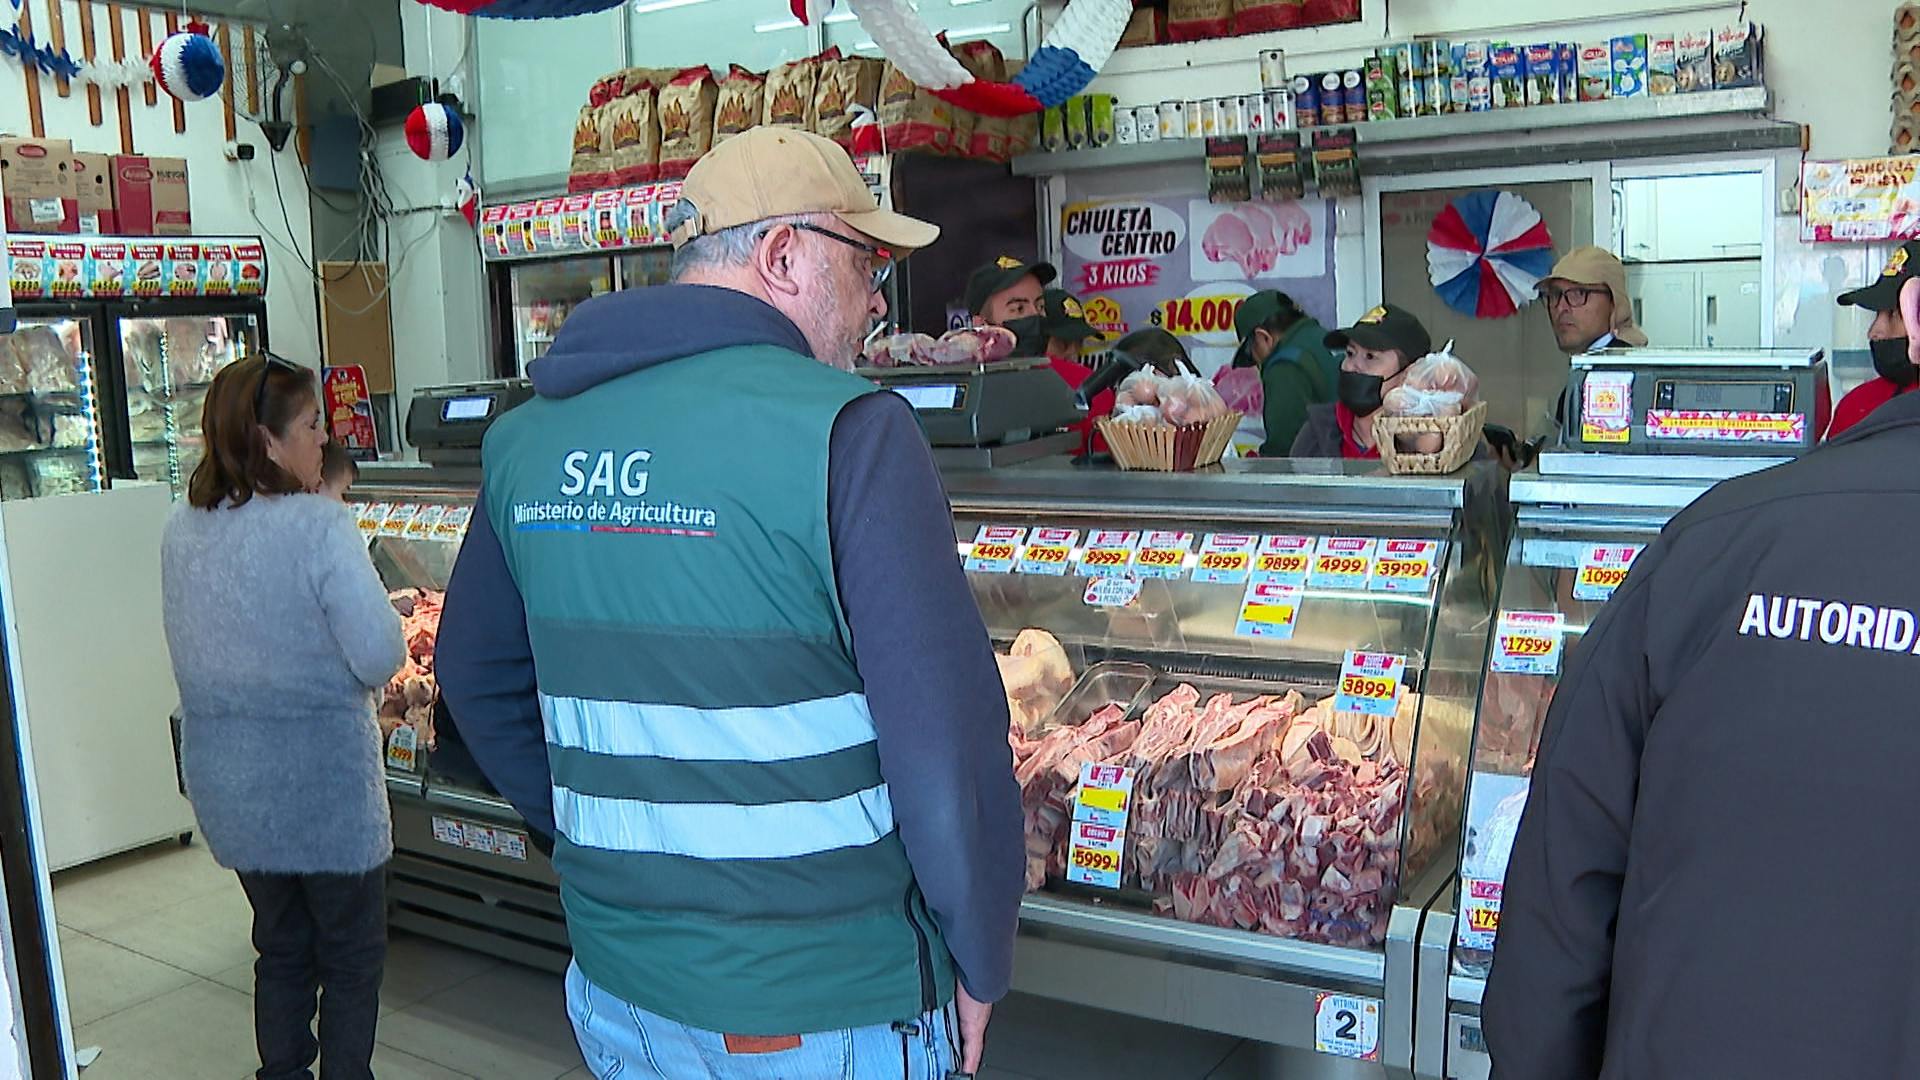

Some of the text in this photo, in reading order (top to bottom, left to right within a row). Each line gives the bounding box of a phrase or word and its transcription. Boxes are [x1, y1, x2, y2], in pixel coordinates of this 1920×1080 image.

[1066, 207, 1152, 236] CHULETA
[1102, 231, 1176, 256] CENTRO
[1088, 263, 1147, 286] 3 KILOS
[1151, 298, 1245, 332] $14.00
[560, 449, 652, 497] SAG
[513, 500, 716, 528] Ministerio de Agricultura
[978, 545, 1010, 558] 4499
[1028, 547, 1064, 562] 4799
[1086, 551, 1121, 564] 9999
[1140, 549, 1175, 564] 8299
[1203, 554, 1242, 569] 4999
[1264, 556, 1301, 570] 9899
[1320, 558, 1362, 573] 4999
[1380, 562, 1423, 577] 3999
[1507, 637, 1553, 653] 17999
[1343, 679, 1387, 698] 3899
[1075, 850, 1112, 870] 5999
[1336, 1010, 1357, 1040] 2
